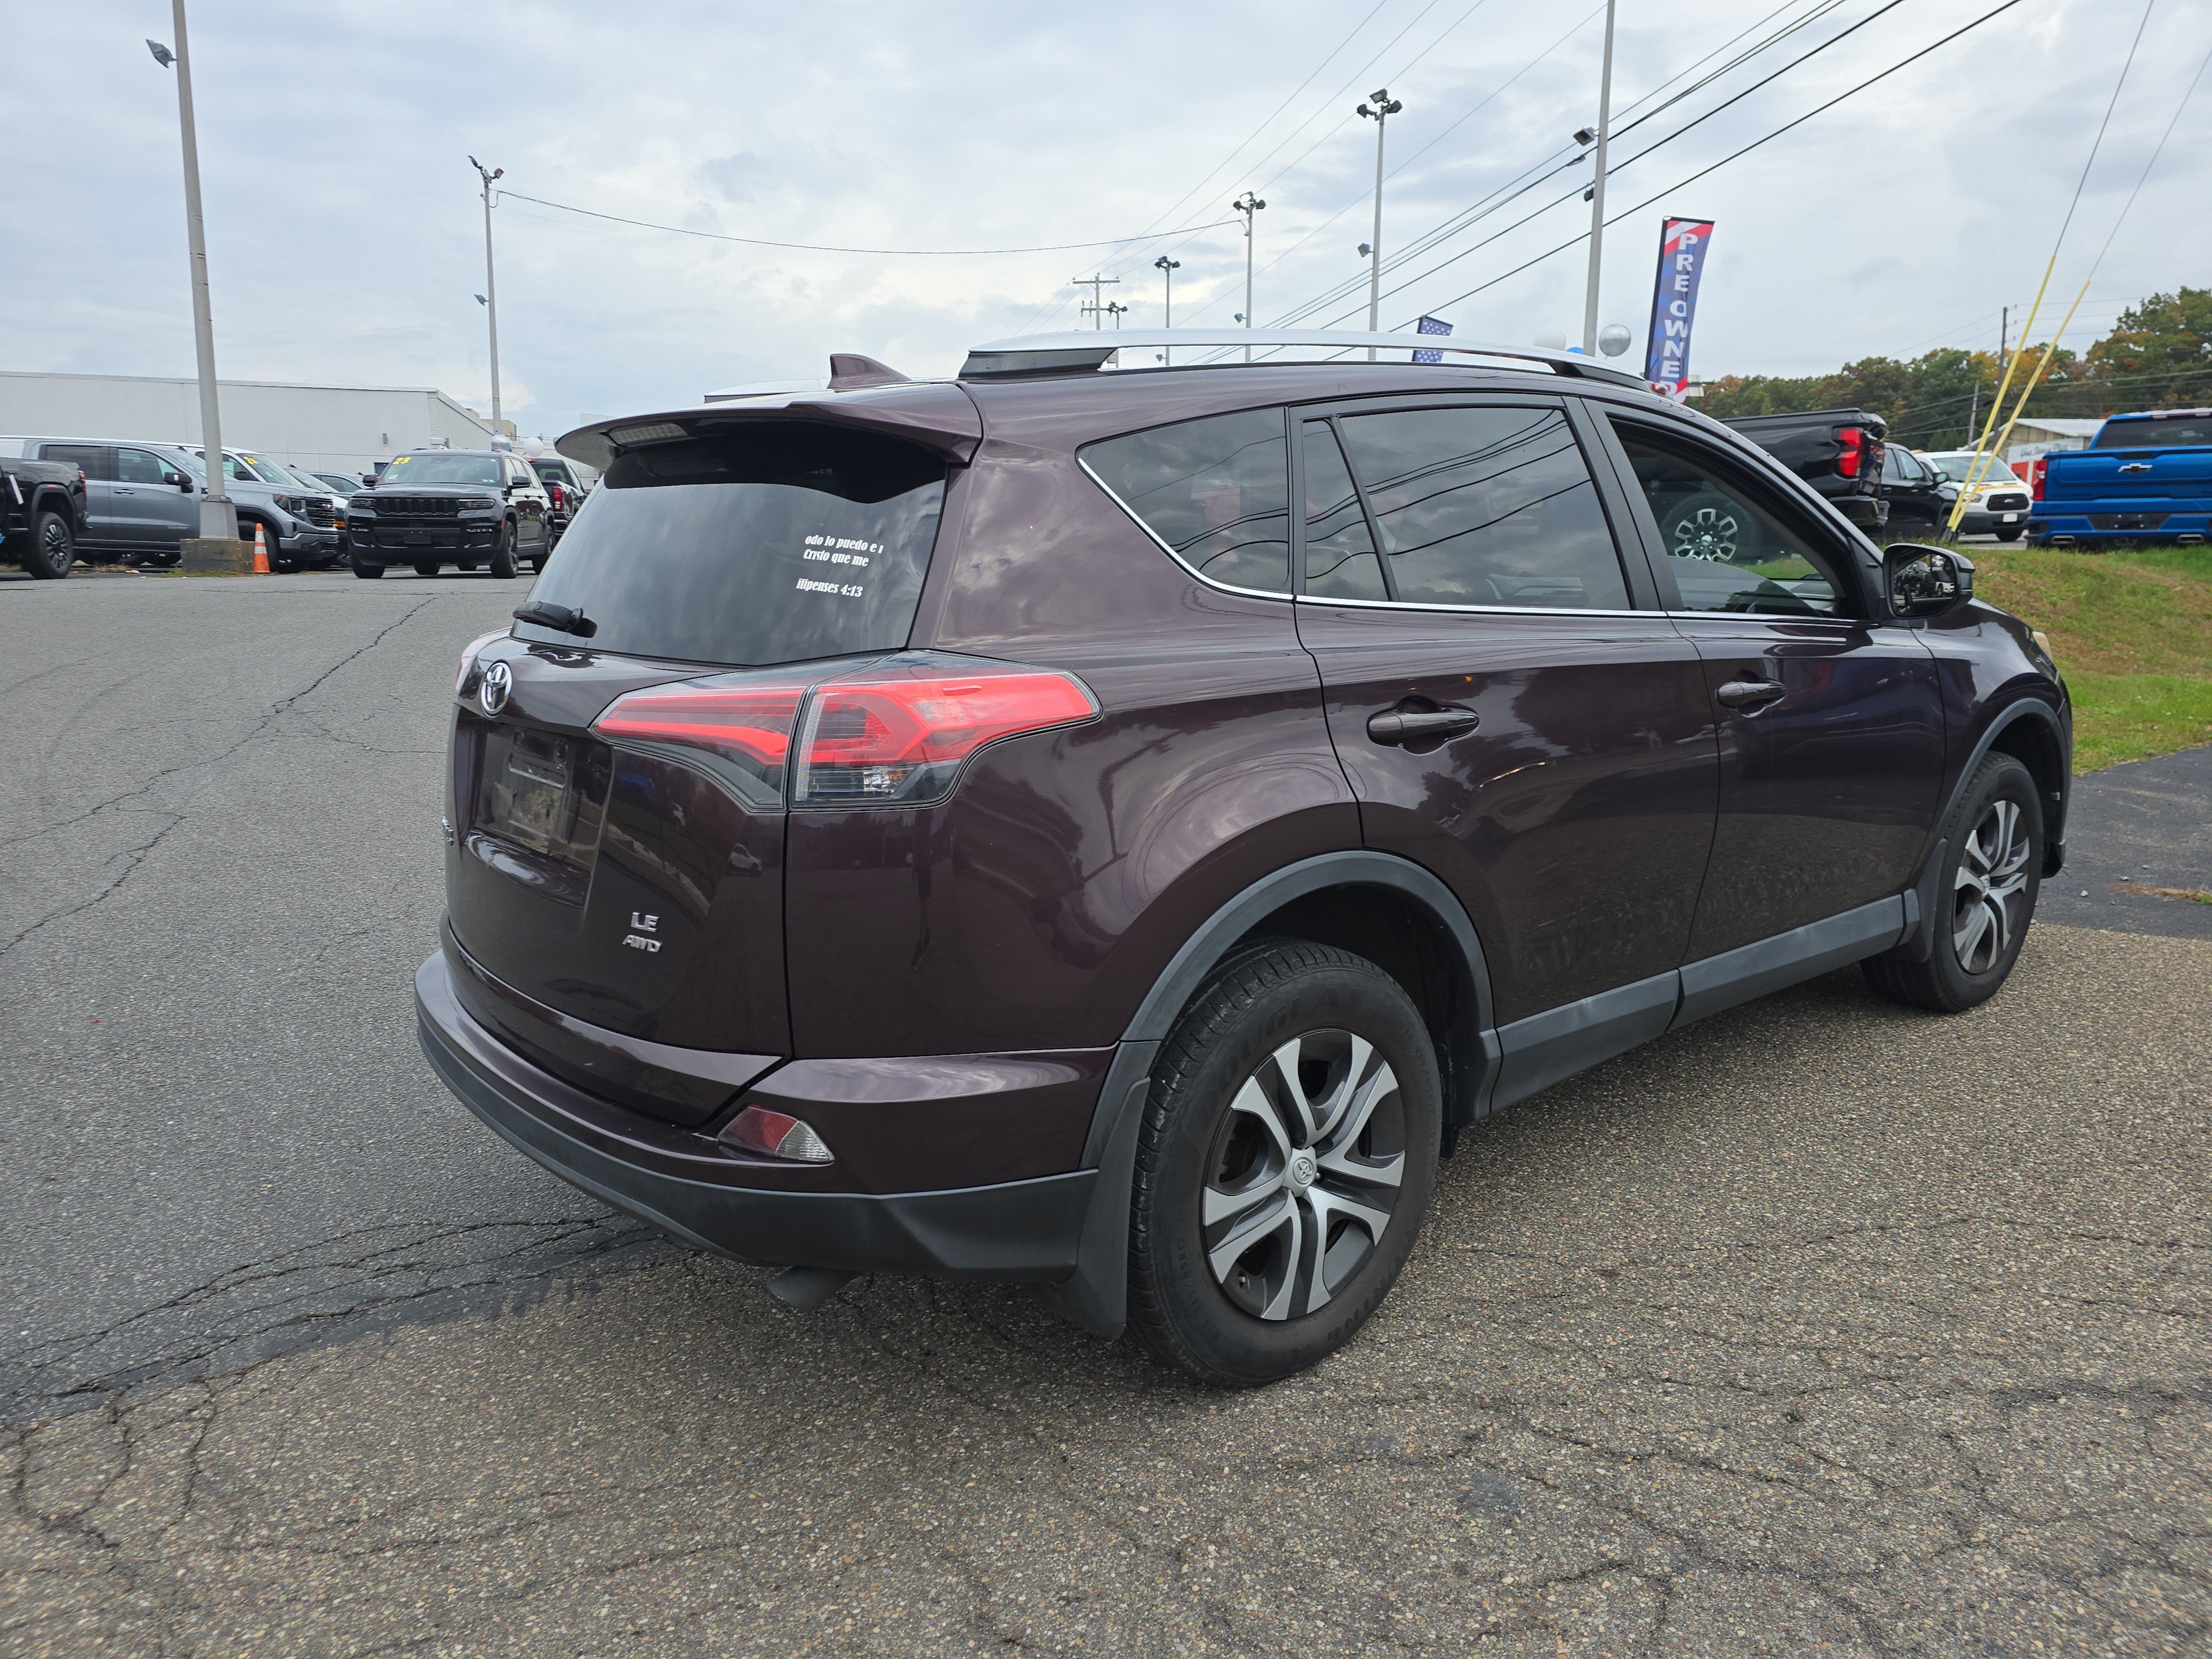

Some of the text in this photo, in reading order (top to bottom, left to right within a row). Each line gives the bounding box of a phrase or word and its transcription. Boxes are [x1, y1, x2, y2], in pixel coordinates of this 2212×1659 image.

[1674, 233, 1698, 292] PRE
[824, 536, 835, 546] lo
[835, 538, 869, 551] puedo
[803, 549, 869, 567] Cristo que me
[840, 584, 863, 597] 4:13
[631, 912, 660, 933] LE
[622, 935, 662, 953] AWD
[1196, 986, 1368, 1133] DOUGLAS
